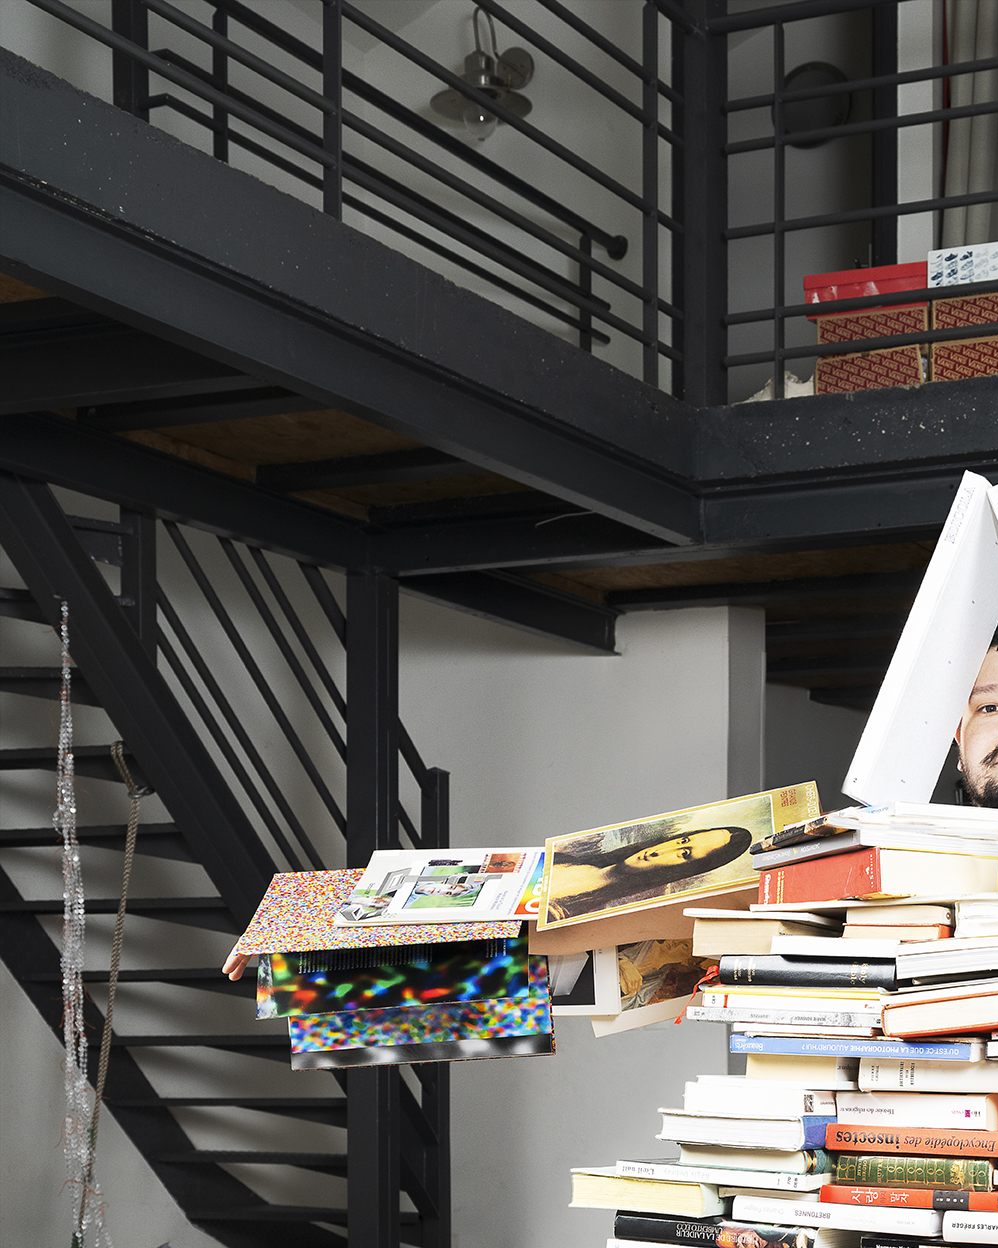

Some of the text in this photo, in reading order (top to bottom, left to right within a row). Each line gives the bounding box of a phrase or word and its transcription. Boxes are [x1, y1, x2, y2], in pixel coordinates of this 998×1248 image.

[963, 302, 982, 314] VANS
[975, 342, 994, 354] VANS
[944, 486, 976, 544] EDICOLA
[850, 1044, 960, 1055] QU'EST-CE QUE LA PHOTOGRAPHIE
[835, 1130, 997, 1153] Encyclopédie des insectes
[794, 1209, 831, 1220] BRETONNES
[676, 1223, 723, 1233] UMBERTO ECO
[951, 1222, 977, 1231] FRÉGER
[675, 1230, 707, 1240] LAIDEUR
